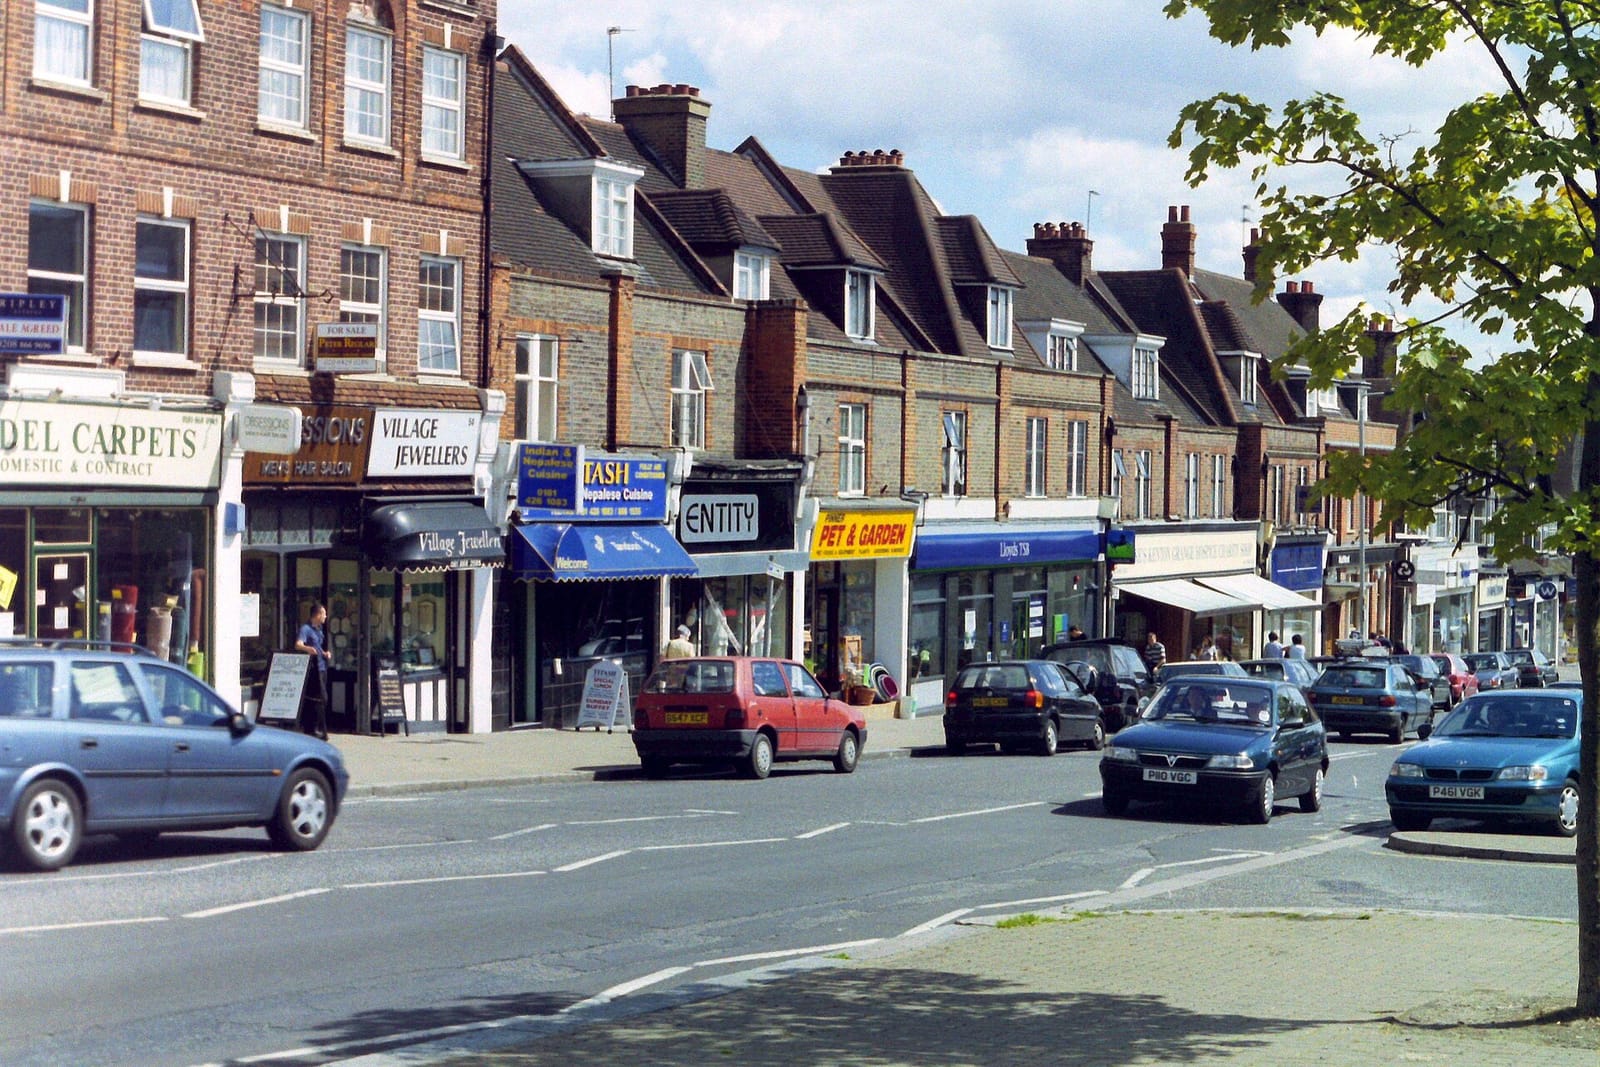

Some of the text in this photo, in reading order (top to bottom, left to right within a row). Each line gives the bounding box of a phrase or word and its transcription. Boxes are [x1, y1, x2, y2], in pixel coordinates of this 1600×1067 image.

[22, 323, 60, 333] AGREED
[327, 326, 366, 335] FOR SALE
[383, 418, 439, 439] VILLAGE
[72, 421, 196, 459] CARPETS
[394, 445, 469, 470] JEWELLERS
[525, 447, 571, 457] Indian &
[70, 461, 78, 473] &
[86, 461, 153, 477] CONTRACT
[261, 460, 353, 475] MEN'S HAIR SALON
[523, 456, 574, 468] Nepalese
[528, 469, 568, 480] Cuisine
[584, 488, 654, 503] Nepalese Cuisine
[686, 503, 754, 534] ENTITY
[818, 523, 907, 547] PET & GARDEN
[419, 531, 455, 557] Village
[1000, 541, 1030, 561] Lloyds TSB
[556, 556, 589, 569] Welcome
[1170, 771, 1192, 782] VGC
[1433, 786, 1481, 798] P461 VGK
